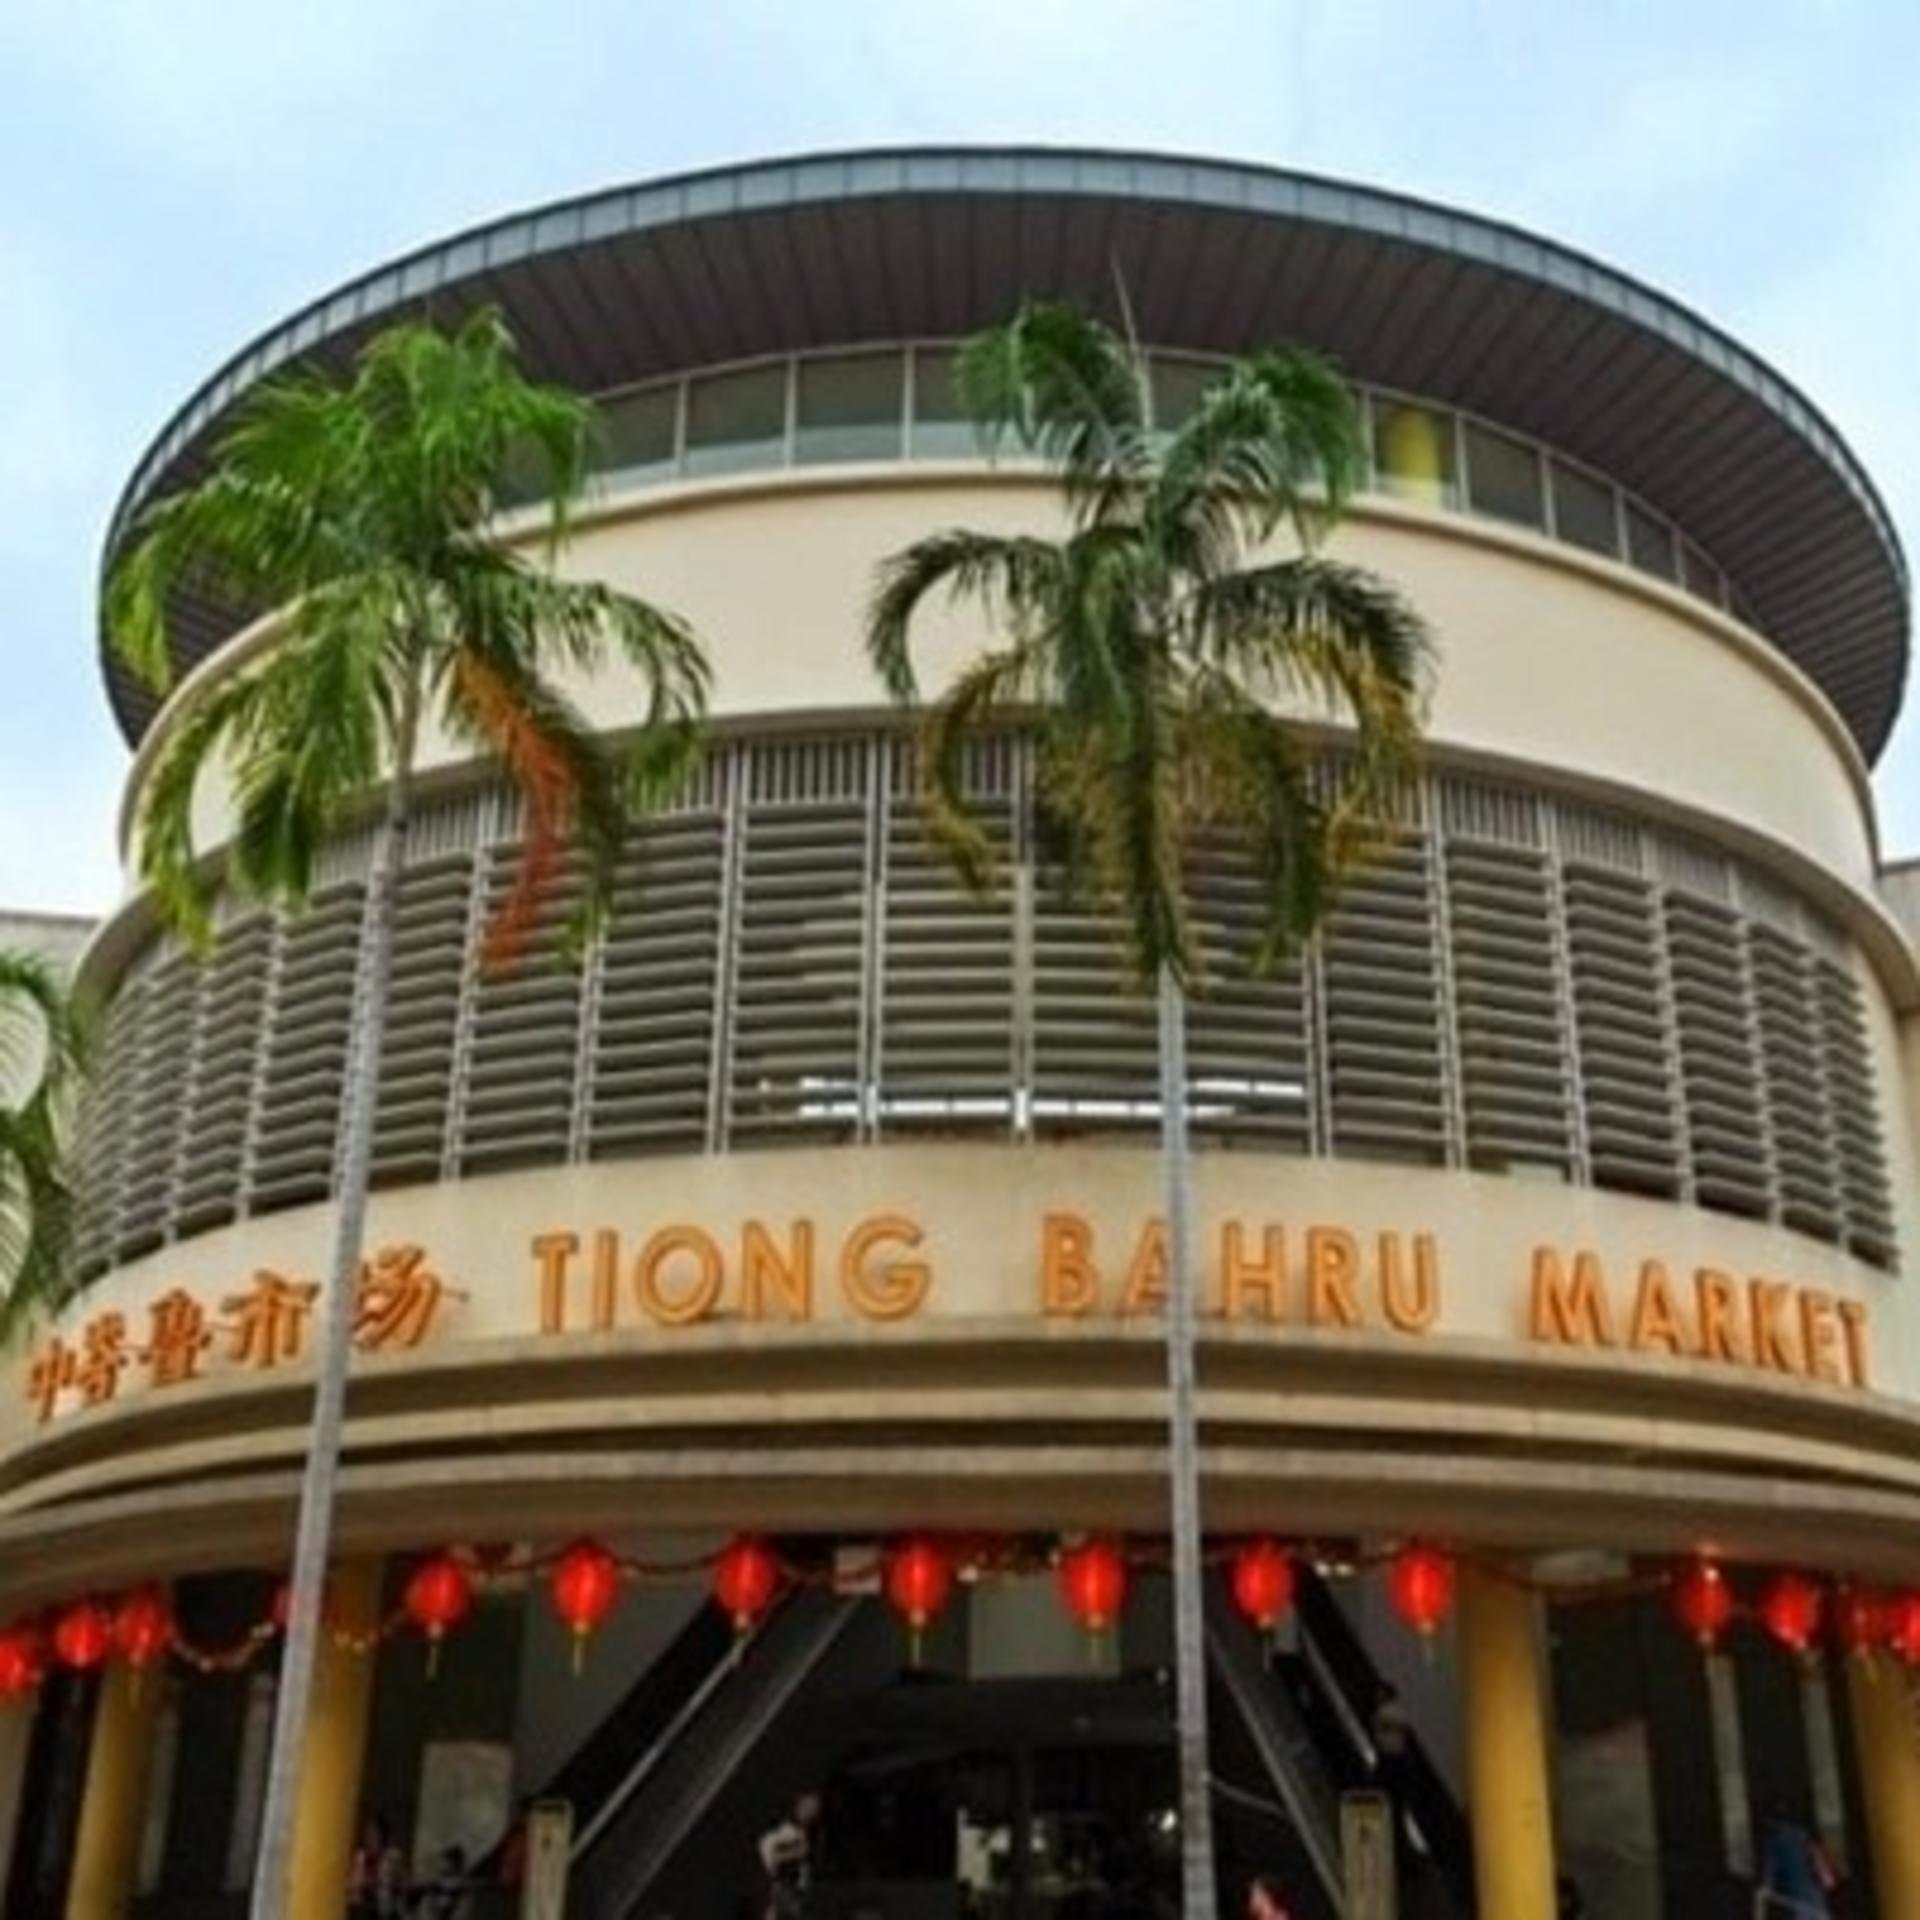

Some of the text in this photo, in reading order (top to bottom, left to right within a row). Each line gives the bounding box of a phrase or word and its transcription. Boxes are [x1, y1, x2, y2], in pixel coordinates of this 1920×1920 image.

[531, 1213, 1869, 1387] TIONG BAHRU MARKET
